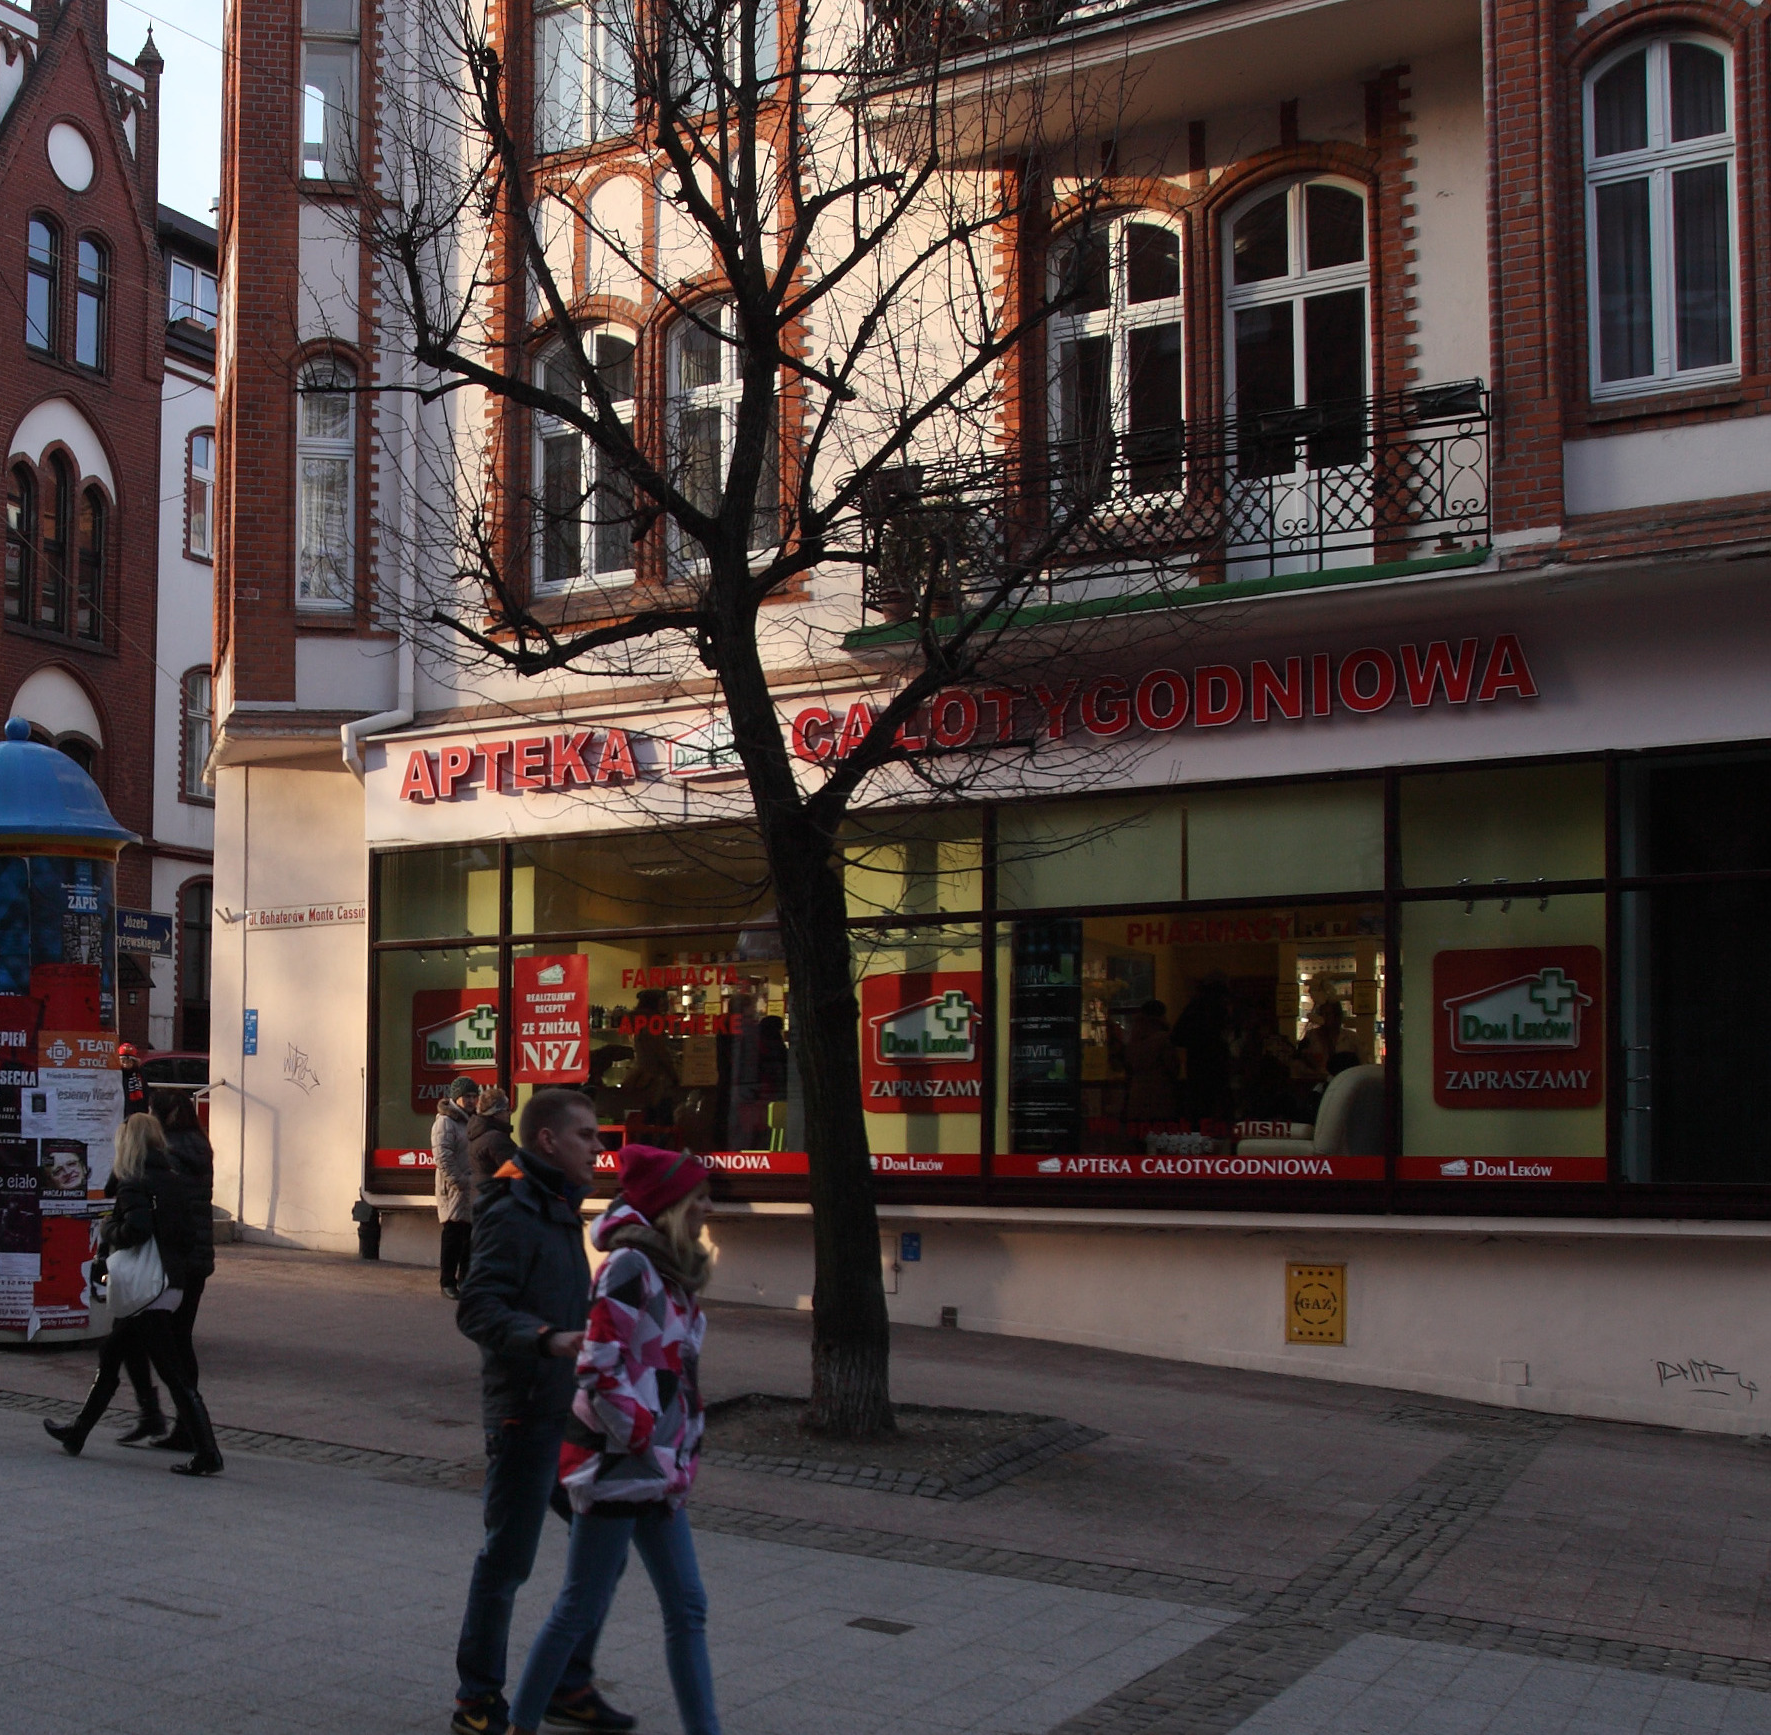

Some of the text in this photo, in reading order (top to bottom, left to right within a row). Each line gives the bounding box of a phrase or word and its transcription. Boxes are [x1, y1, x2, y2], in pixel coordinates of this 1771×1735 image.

[399, 729, 638, 801] APTEKA
[68, 895, 99, 910] ZAPIS
[124, 915, 149, 930] Józefa
[260, 909, 305, 925] Bohaterów
[309, 906, 334, 922] Monte
[338, 904, 366, 920] Cassin
[1127, 917, 1294, 945] PHARMACY
[117, 934, 161, 952] yżewskiego
[622, 965, 739, 989] FARMACIA
[526, 992, 576, 1003] REALIZUJEMY
[535, 1004, 567, 1014] RECEPTY
[522, 1018, 581, 1037] ZE ZNIŻKĄ
[619, 1013, 744, 1036] APOTHEKE
[77, 1039, 115, 1053] TEATR
[79, 1058, 107, 1067] STOLE
[521, 1040, 583, 1071] NFZ
[869, 1080, 983, 1098] ZAPRASZAMY
[1444, 1070, 1591, 1090] ZAPRASZAMY
[1067, 1158, 1333, 1176] APTEKA CAŁOTYGODNIOWA
[1300, 1298, 1332, 1310] GAZ
